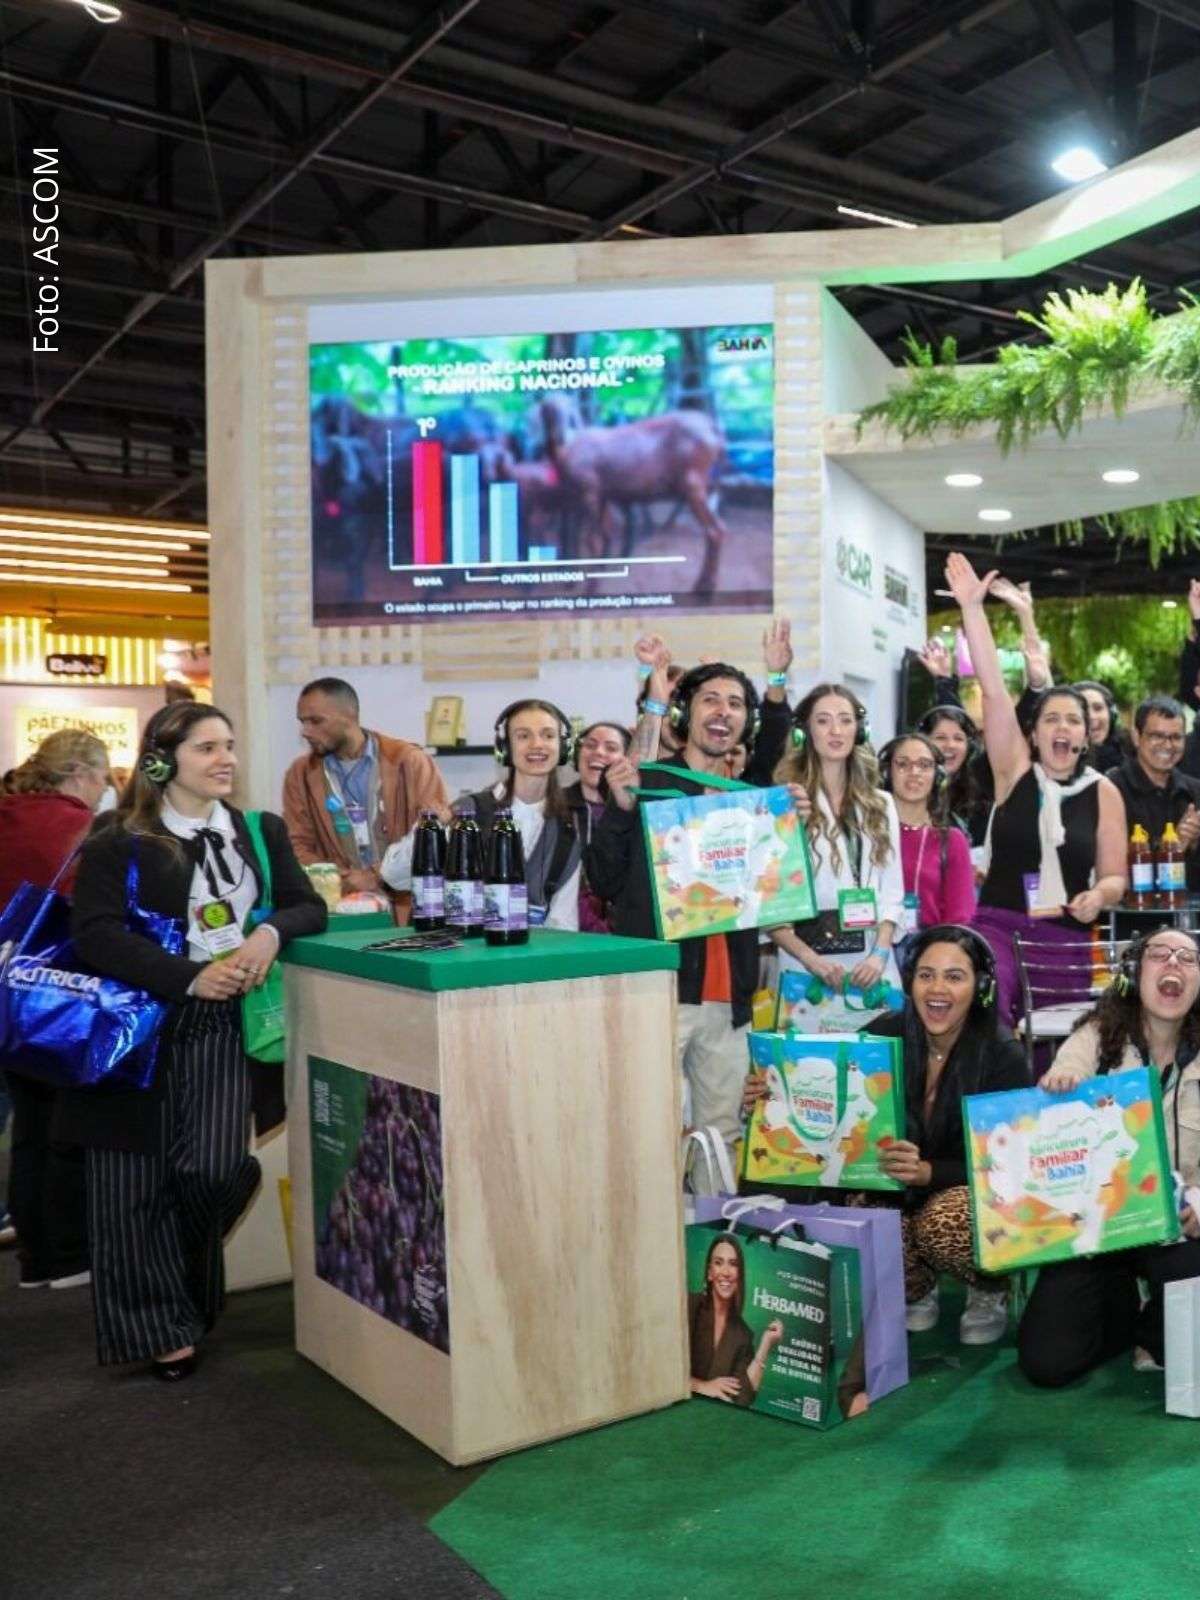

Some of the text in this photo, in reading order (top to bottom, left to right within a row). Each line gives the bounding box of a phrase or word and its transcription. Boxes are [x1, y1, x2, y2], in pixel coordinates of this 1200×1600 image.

[388, 354, 666, 379] PRODUÇÃO DE CAPRINOS E OVINOS
[423, 375, 516, 394] RANKING
[520, 371, 623, 391] NACIONAL
[413, 571, 585, 587] BAHIA OUTROS ESTADOS
[384, 603, 394, 614] O
[395, 602, 426, 613] estado
[427, 603, 455, 615] ocupa
[464, 601, 501, 613] primeiro
[502, 600, 525, 612] lugar
[527, 602, 539, 610] no
[540, 598, 574, 611] ranking
[589, 596, 632, 609] produção
[1029, 1148, 1089, 1170] Familiar
[1047, 1163, 1087, 1181] Bahia
[753, 1286, 826, 1324] HERBAMED
